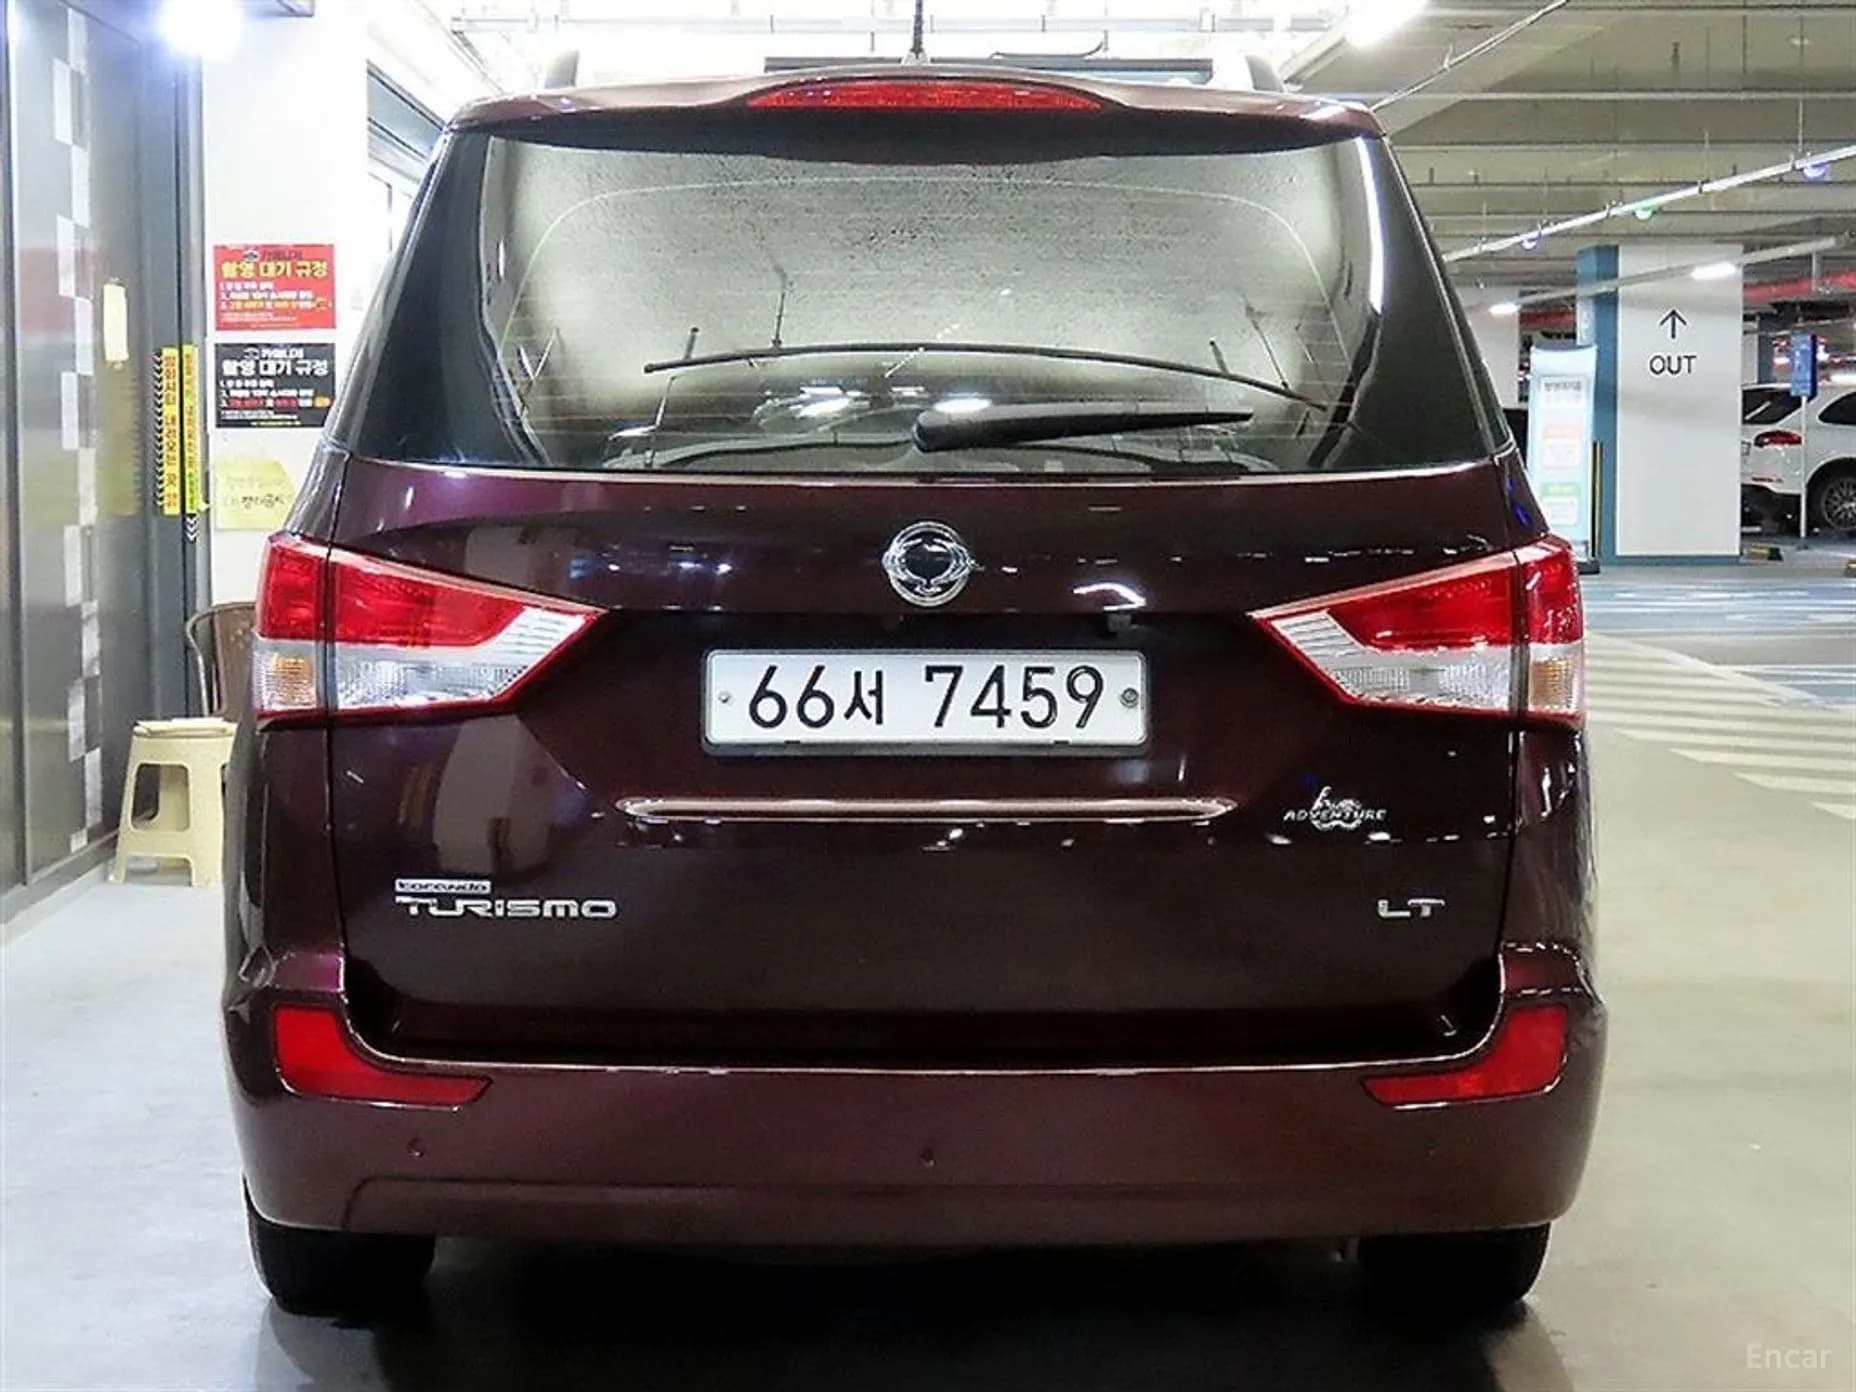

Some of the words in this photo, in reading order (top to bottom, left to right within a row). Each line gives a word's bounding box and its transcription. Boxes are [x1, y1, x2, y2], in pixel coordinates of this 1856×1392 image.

[260, 260, 292, 278] 대기
[296, 260, 328, 278] 규정
[260, 359, 292, 378] 대기
[296, 359, 329, 378] 규정
[1649, 355, 1697, 375] OUT
[748, 664, 884, 729] 66서
[924, 664, 1105, 729] 7459
[1377, 899, 1446, 918] LT
